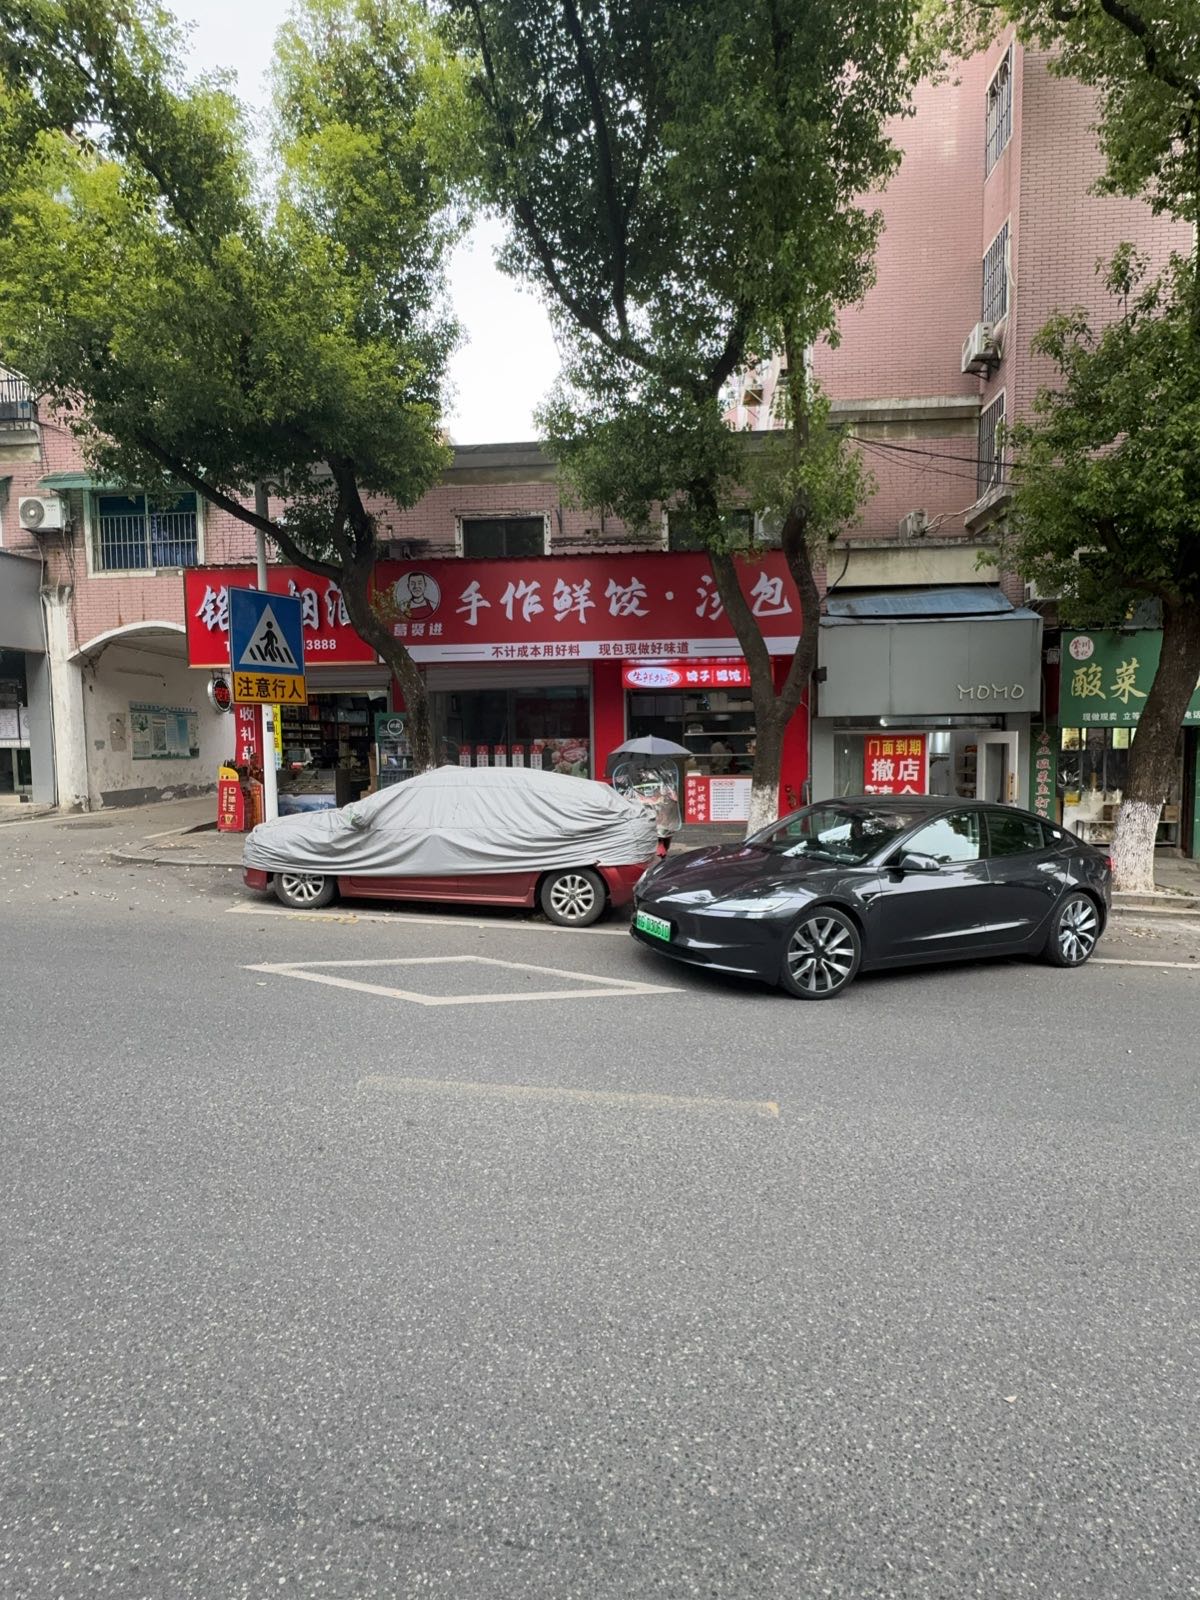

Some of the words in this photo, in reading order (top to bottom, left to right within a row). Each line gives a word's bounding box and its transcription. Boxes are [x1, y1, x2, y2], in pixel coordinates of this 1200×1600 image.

[492, 643, 580, 658] 不计成本用好料
[599, 642, 689, 657] 现包现做好味道
[238, 677, 302, 699] 注意行人
[1071, 657, 1147, 704] 酸菜
[957, 683, 1024, 700] MOMO
[869, 739, 921, 756] 门面到期
[871, 758, 920, 782] 撤店
